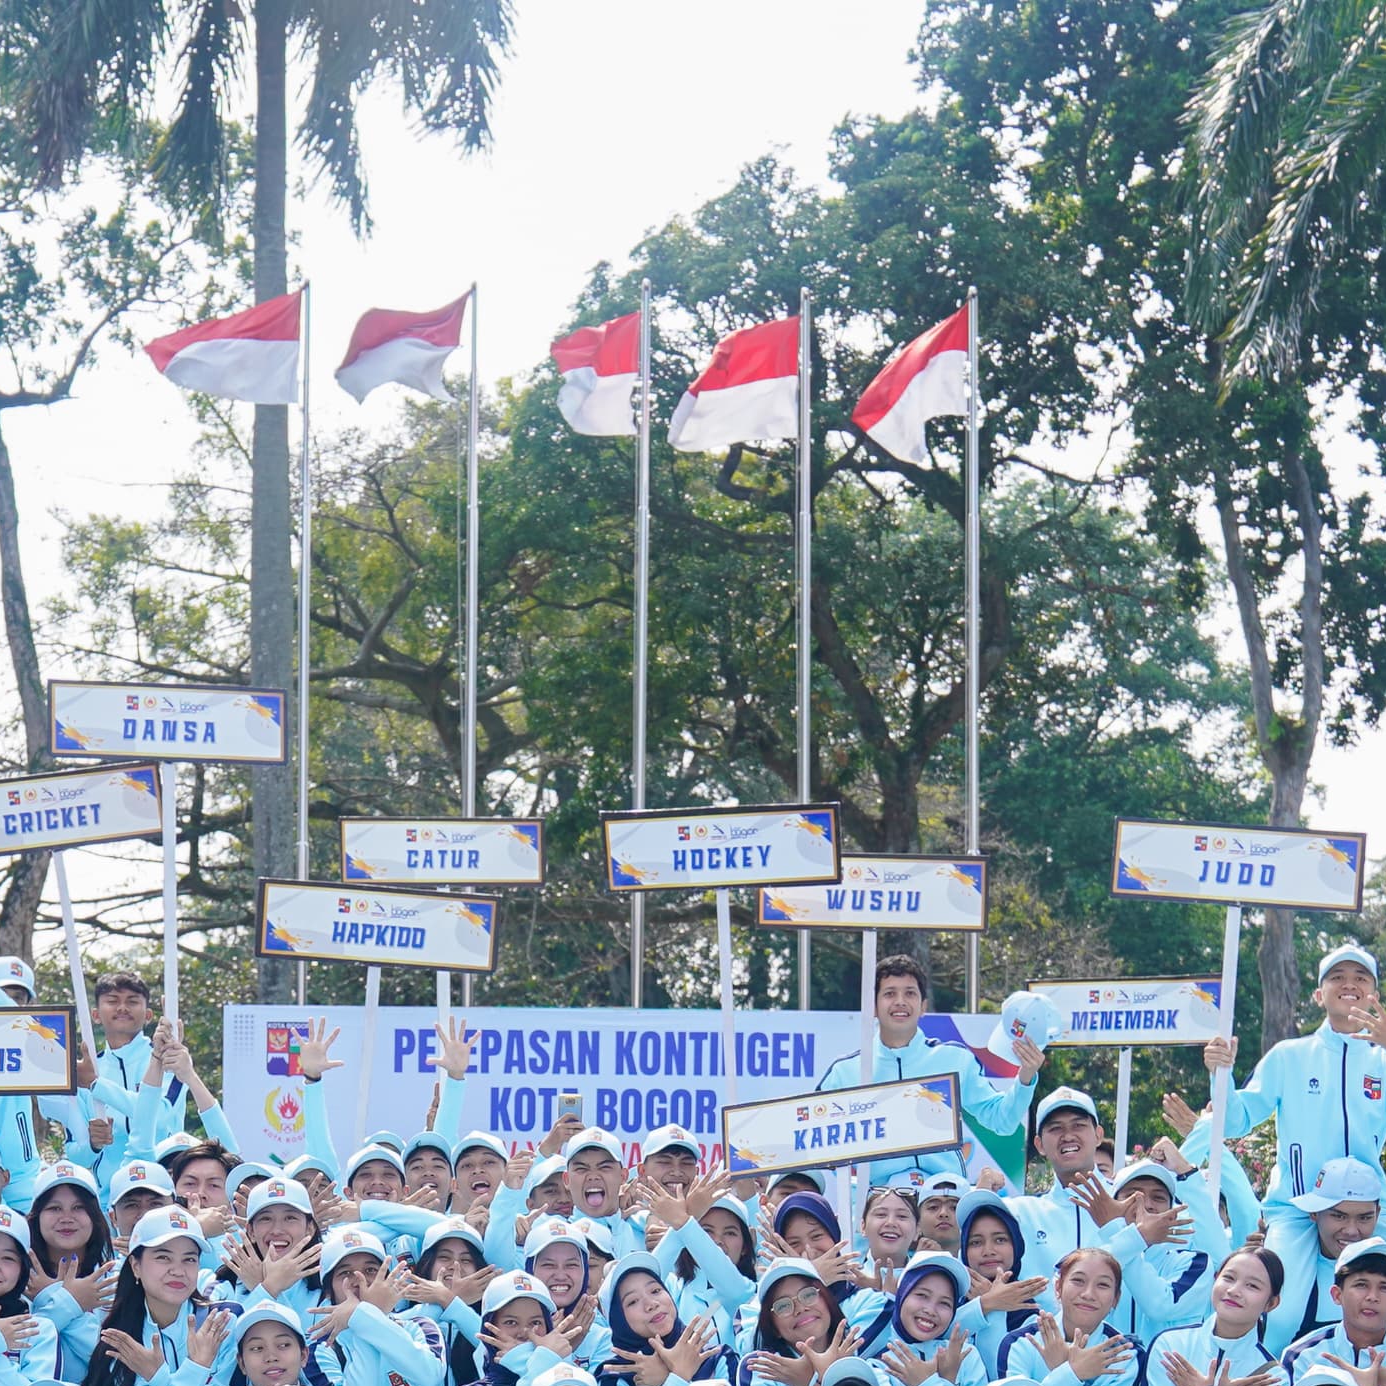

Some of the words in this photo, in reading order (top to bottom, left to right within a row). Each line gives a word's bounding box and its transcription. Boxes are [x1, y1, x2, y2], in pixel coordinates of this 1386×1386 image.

[123, 718, 216, 743] DANSA
[3, 804, 101, 835] CRICKET
[407, 849, 480, 870] CATUR
[672, 845, 771, 871] HOCKEY
[1199, 860, 1276, 886] JUDO
[827, 889, 921, 912] WUSHU
[332, 921, 425, 949] HAPKIDO
[1071, 1009, 1180, 1031] MENEMBAK
[394, 1028, 600, 1075] PEEPASAN
[490, 1087, 579, 1132] KOT
[596, 1088, 717, 1134] BOGOR
[793, 1117, 886, 1151] KARATE
